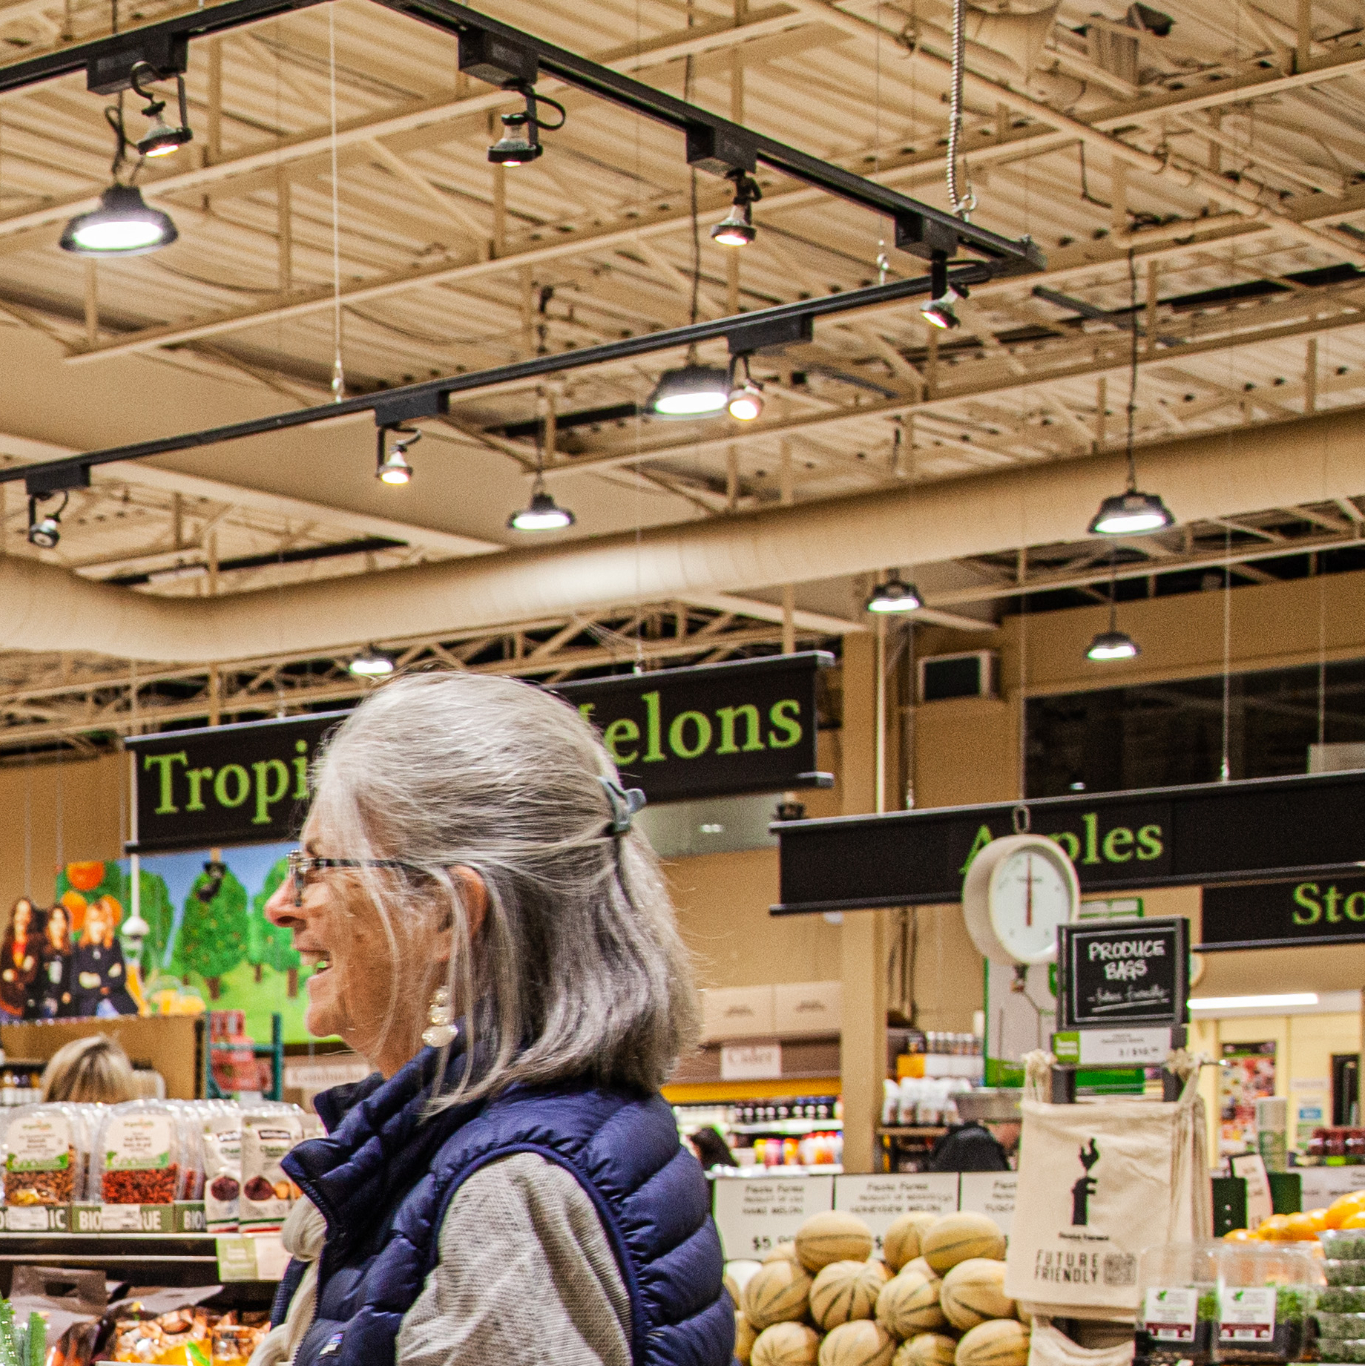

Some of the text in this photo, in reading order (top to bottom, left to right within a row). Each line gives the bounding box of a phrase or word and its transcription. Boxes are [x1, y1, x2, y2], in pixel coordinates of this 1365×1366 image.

[579, 691, 804, 766] elons
[144, 740, 310, 824] Tropi
[960, 811, 1165, 877] Aples
[1088, 940, 1166, 962] PRODUCE
[1103, 959, 1149, 981] BAGS
[1036, 1249, 1098, 1268] FUTURE
[1034, 1265, 1099, 1284] FRIENDLY
